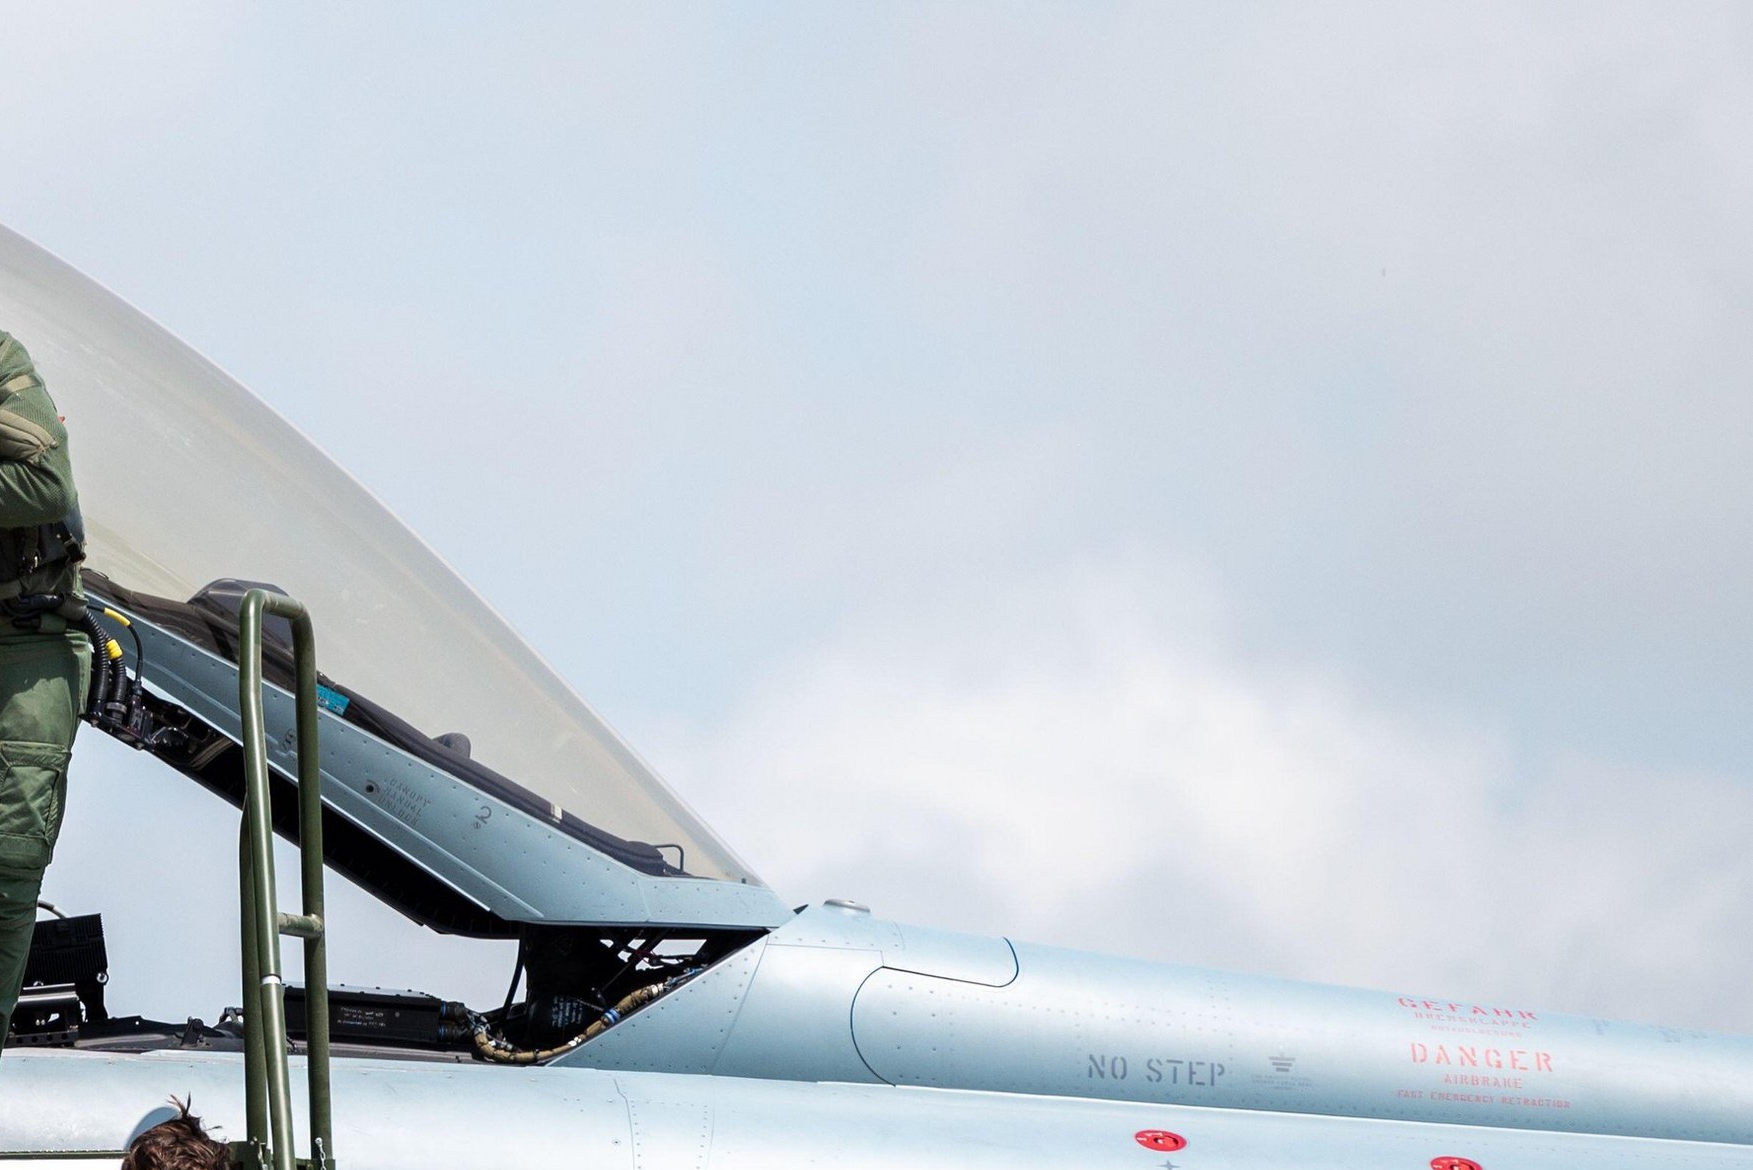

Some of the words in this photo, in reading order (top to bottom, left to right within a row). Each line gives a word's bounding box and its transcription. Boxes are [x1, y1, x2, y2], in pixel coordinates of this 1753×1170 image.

[1398, 997, 1538, 1021] GEFAHR
[1410, 1042, 1553, 1073] DANGER
[1088, 1053, 1128, 1080] NO
[1146, 1057, 1226, 1087] STEP
[1444, 1074, 1523, 1090] AIRBRAKE
[1501, 1096, 1572, 1109] RETRACTION
